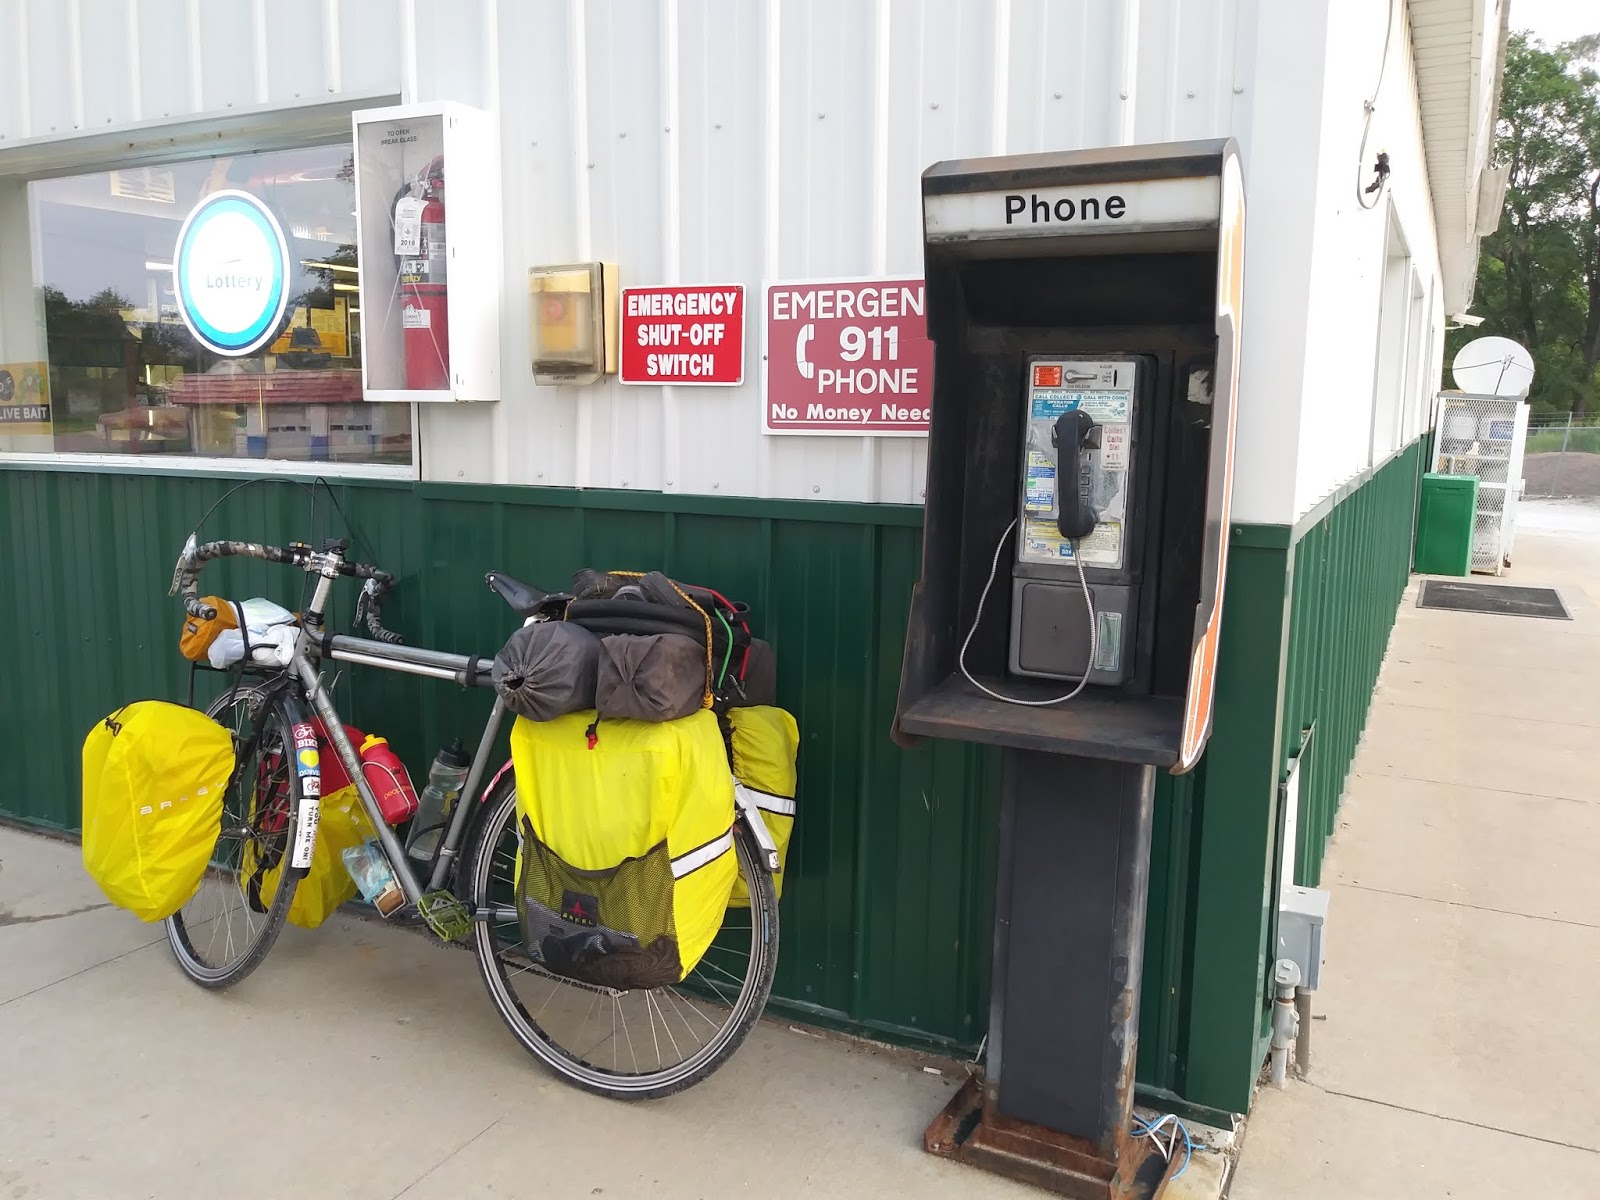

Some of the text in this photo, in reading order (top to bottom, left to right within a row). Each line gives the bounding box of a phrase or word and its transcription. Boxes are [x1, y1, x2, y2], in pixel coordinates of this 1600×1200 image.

[380, 136, 417, 146] BREAK GLASS
[1005, 194, 1126, 224] Phone
[207, 274, 262, 291] Lottery
[627, 292, 737, 317] EMERGENCY
[773, 286, 925, 320] EMERGEN
[637, 323, 725, 347] SHUT-OFF
[839, 326, 898, 362] 911
[646, 353, 714, 376] SWITCH
[818, 368, 918, 394] PHONE
[23, 407, 47, 419] BAIT
[772, 403, 799, 420] No
[806, 403, 873, 424] Money
[304, 831, 311, 843] ME
